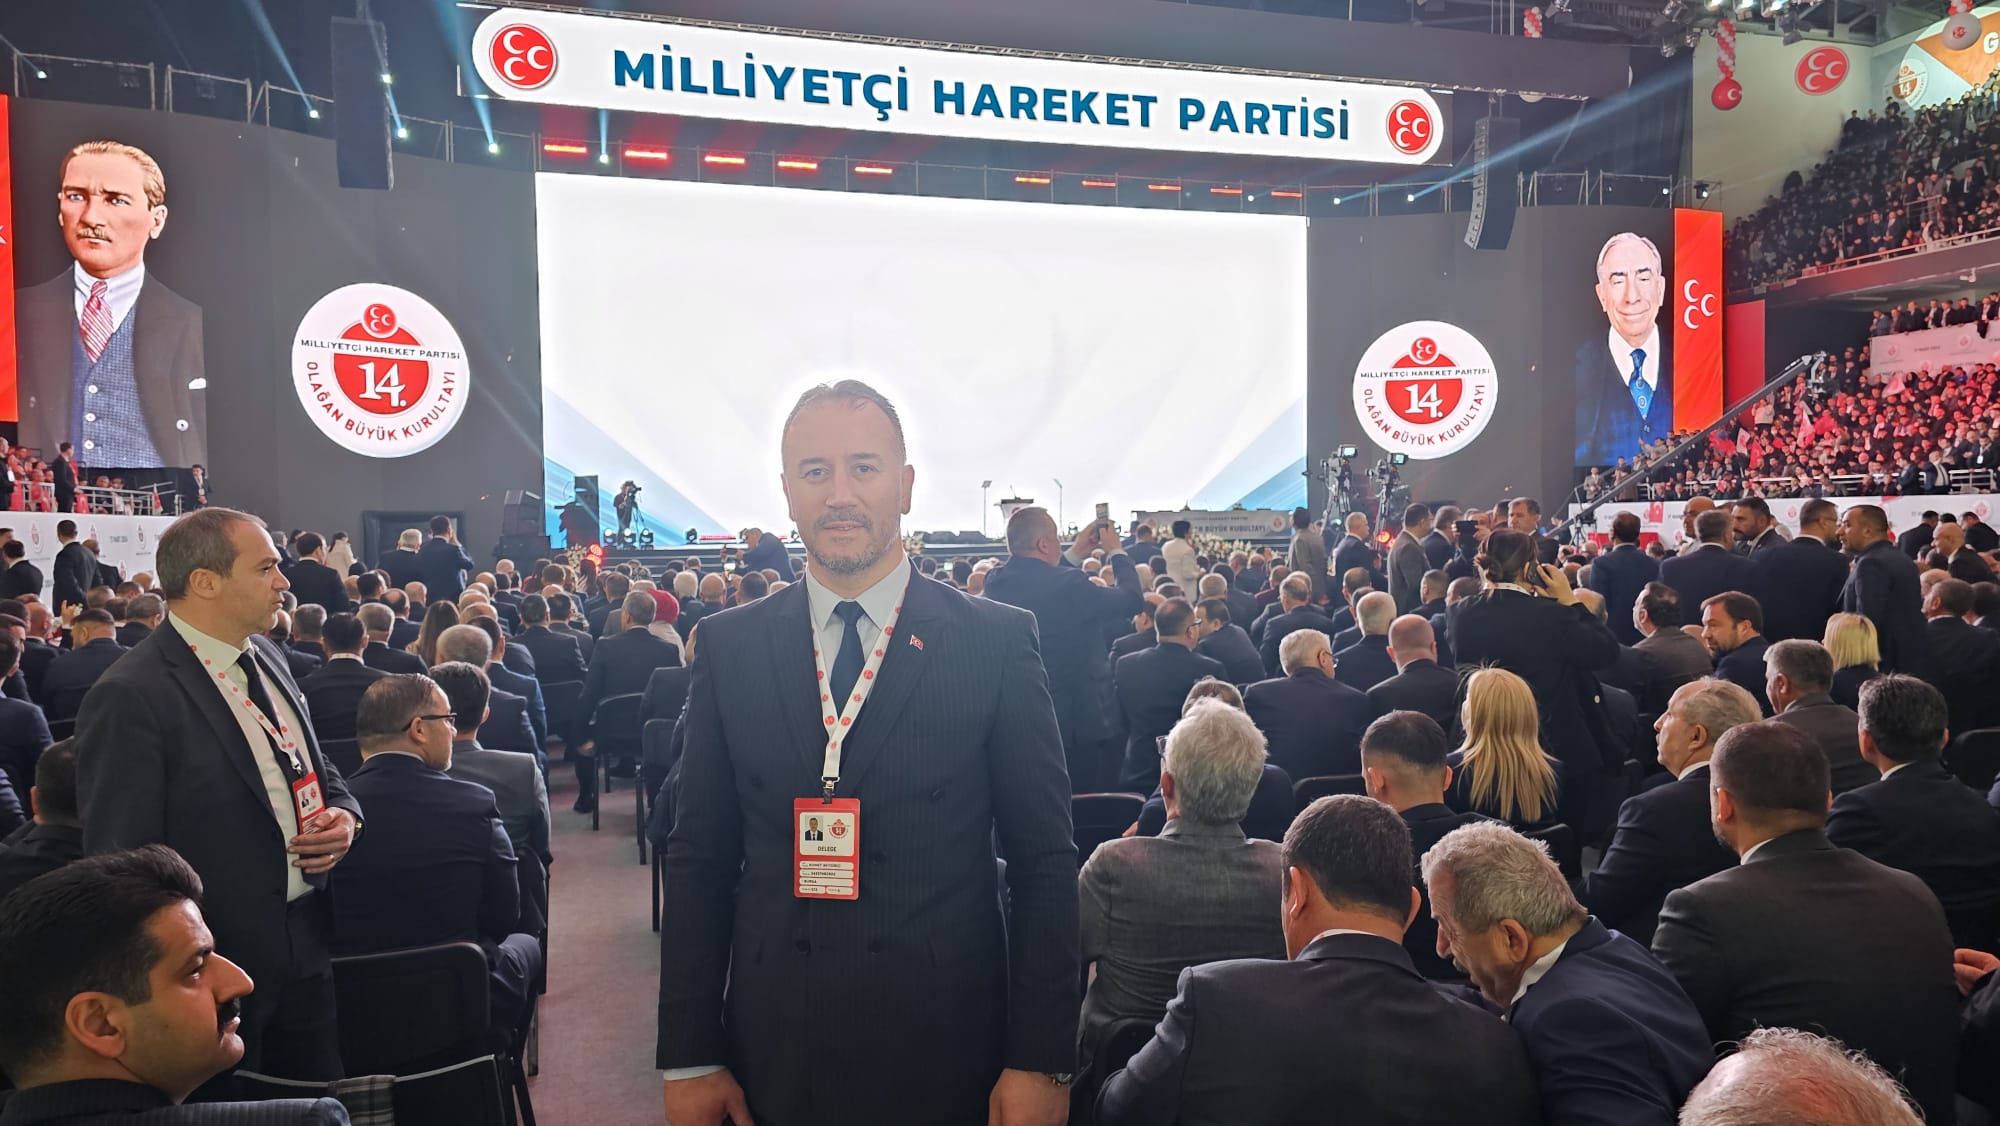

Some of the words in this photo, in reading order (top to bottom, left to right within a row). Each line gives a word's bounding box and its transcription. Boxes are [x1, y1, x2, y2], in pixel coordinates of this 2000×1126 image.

[613, 44, 909, 121] MİLLİYETÇİ
[934, 79, 1158, 128] HAREKET
[1179, 96, 1349, 140] PARTİSİ
[301, 339, 362, 352] MİLLİYETÇİ
[365, 346, 415, 357] HAREKET
[419, 350, 461, 360] PARTİSİ
[357, 361, 408, 407] 14.
[1360, 370, 1409, 378] MİLLİYETÇİ
[1411, 369, 1452, 377] HAREKET
[1455, 368, 1490, 376] PARTİSİ
[306, 361, 343, 422] OLAĞAN
[344, 418, 398, 441] BÜYÜK
[402, 371, 455, 439] KURULTAYI
[1364, 388, 1392, 434] OLAĞAN
[1392, 429, 1435, 446] BÜYÜK
[1439, 384, 1486, 443] KURULTAYI
[1404, 383, 1444, 418] 14.
